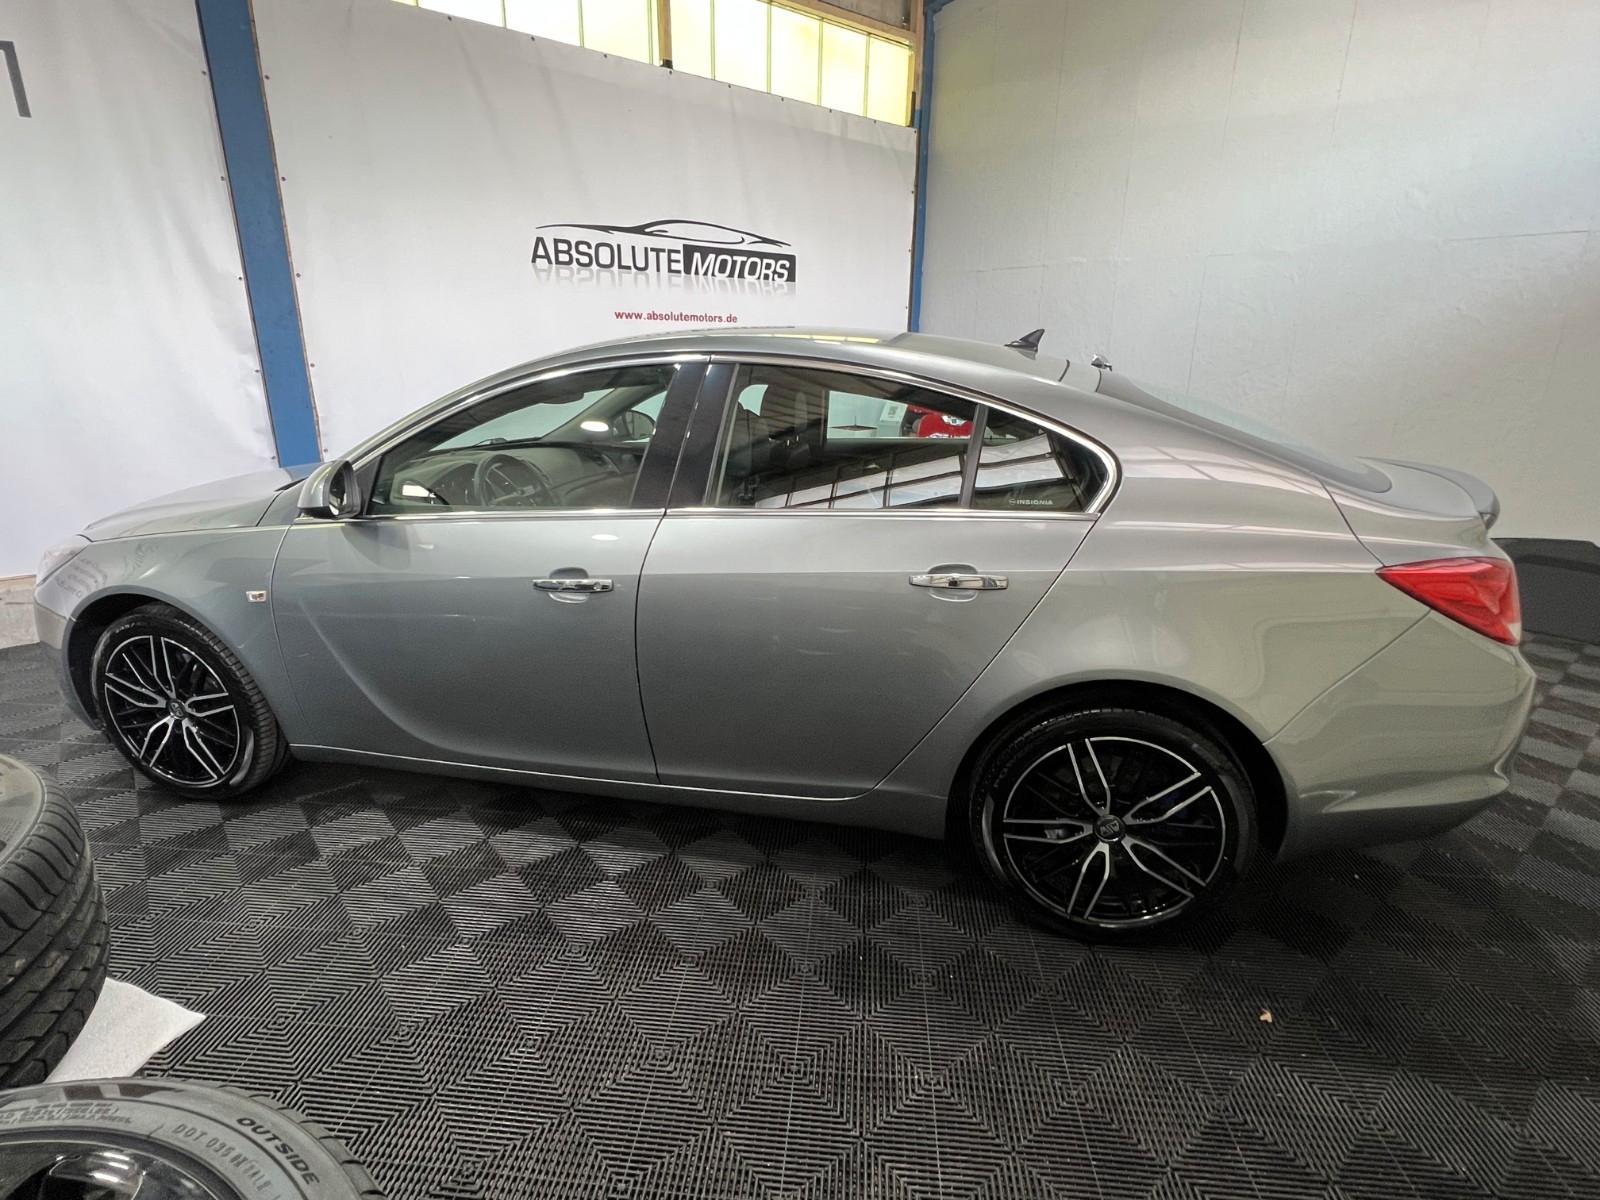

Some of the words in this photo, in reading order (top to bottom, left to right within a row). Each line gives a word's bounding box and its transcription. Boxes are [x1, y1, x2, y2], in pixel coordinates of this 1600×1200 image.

[531, 236, 683, 275] ABSOLUTE
[690, 251, 790, 282] MOTORS
[614, 310, 738, 324] www.absolutemotors.de
[171, 1123, 208, 1142] DOT
[235, 1116, 321, 1186] OUTSIDE
